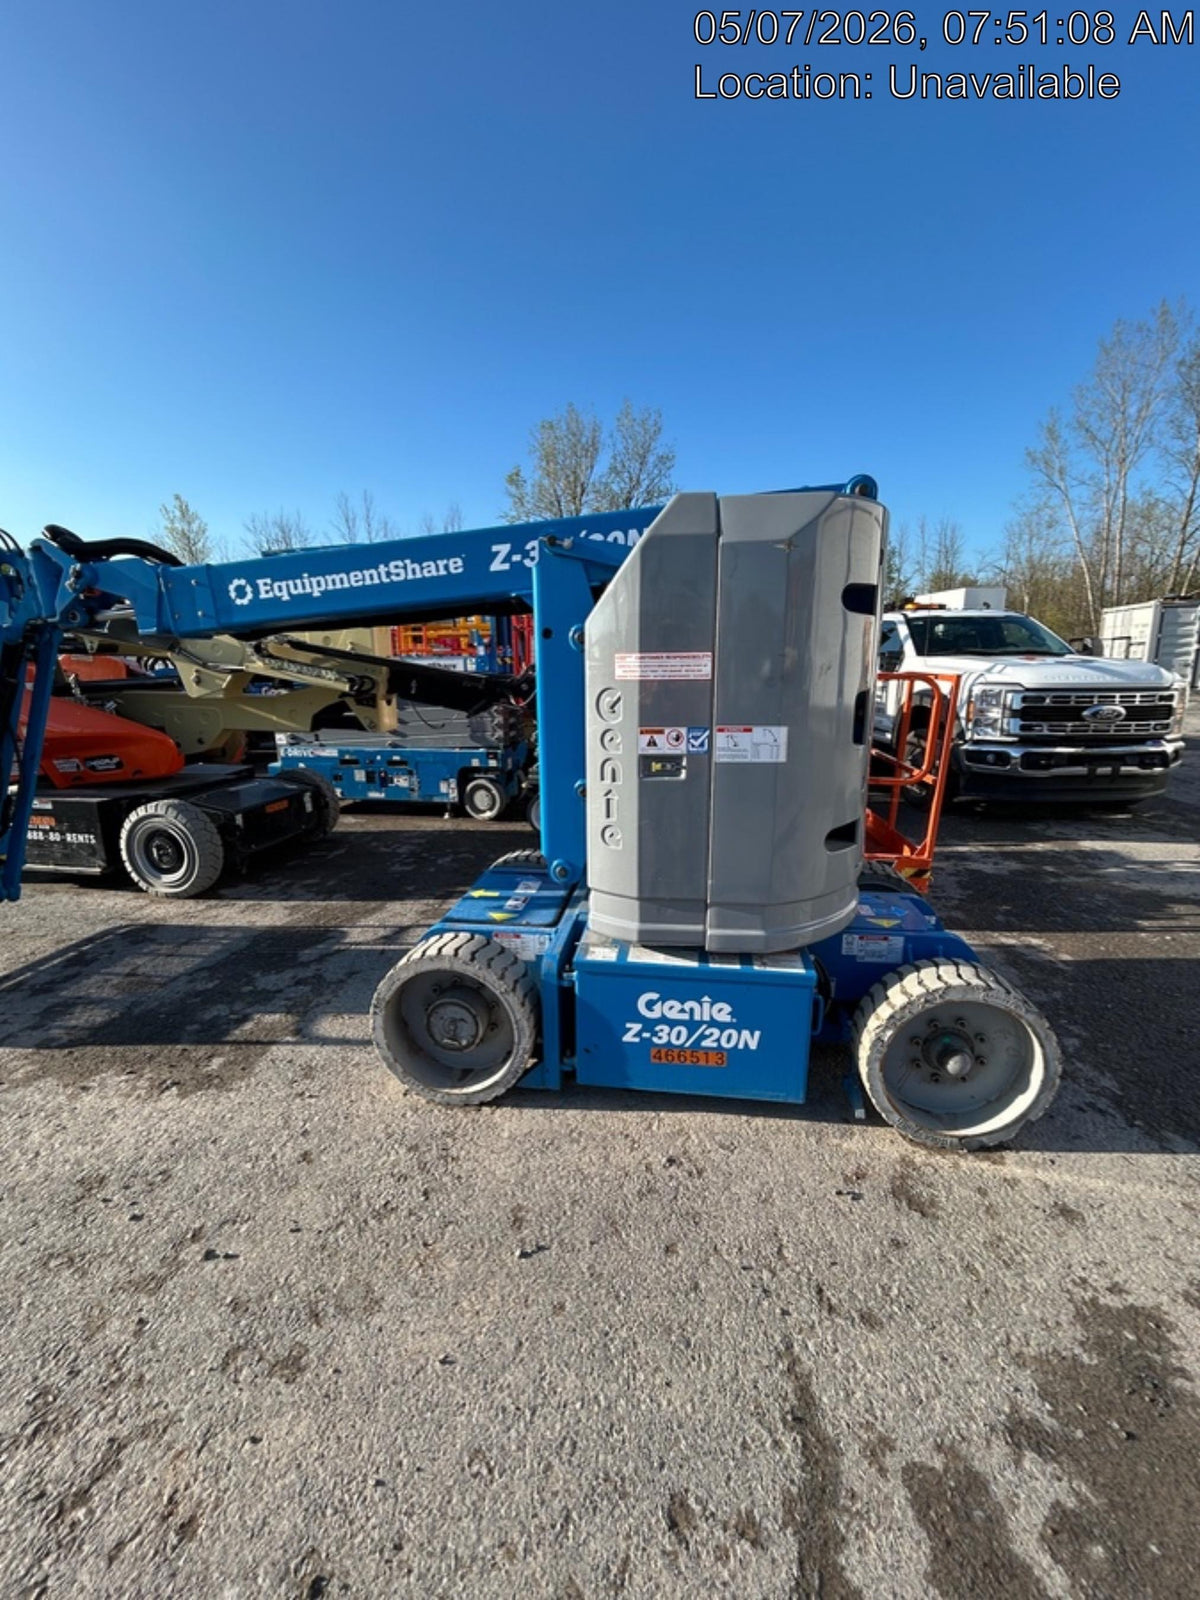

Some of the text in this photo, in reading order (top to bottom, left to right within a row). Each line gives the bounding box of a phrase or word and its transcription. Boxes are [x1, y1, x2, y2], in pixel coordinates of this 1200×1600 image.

[256, 556, 464, 601] EquipmentShare
[595, 687, 623, 850] Genie
[637, 992, 733, 1023] Genie
[621, 1022, 762, 1050] Z-30/20N
[651, 1049, 726, 1066] 466513
